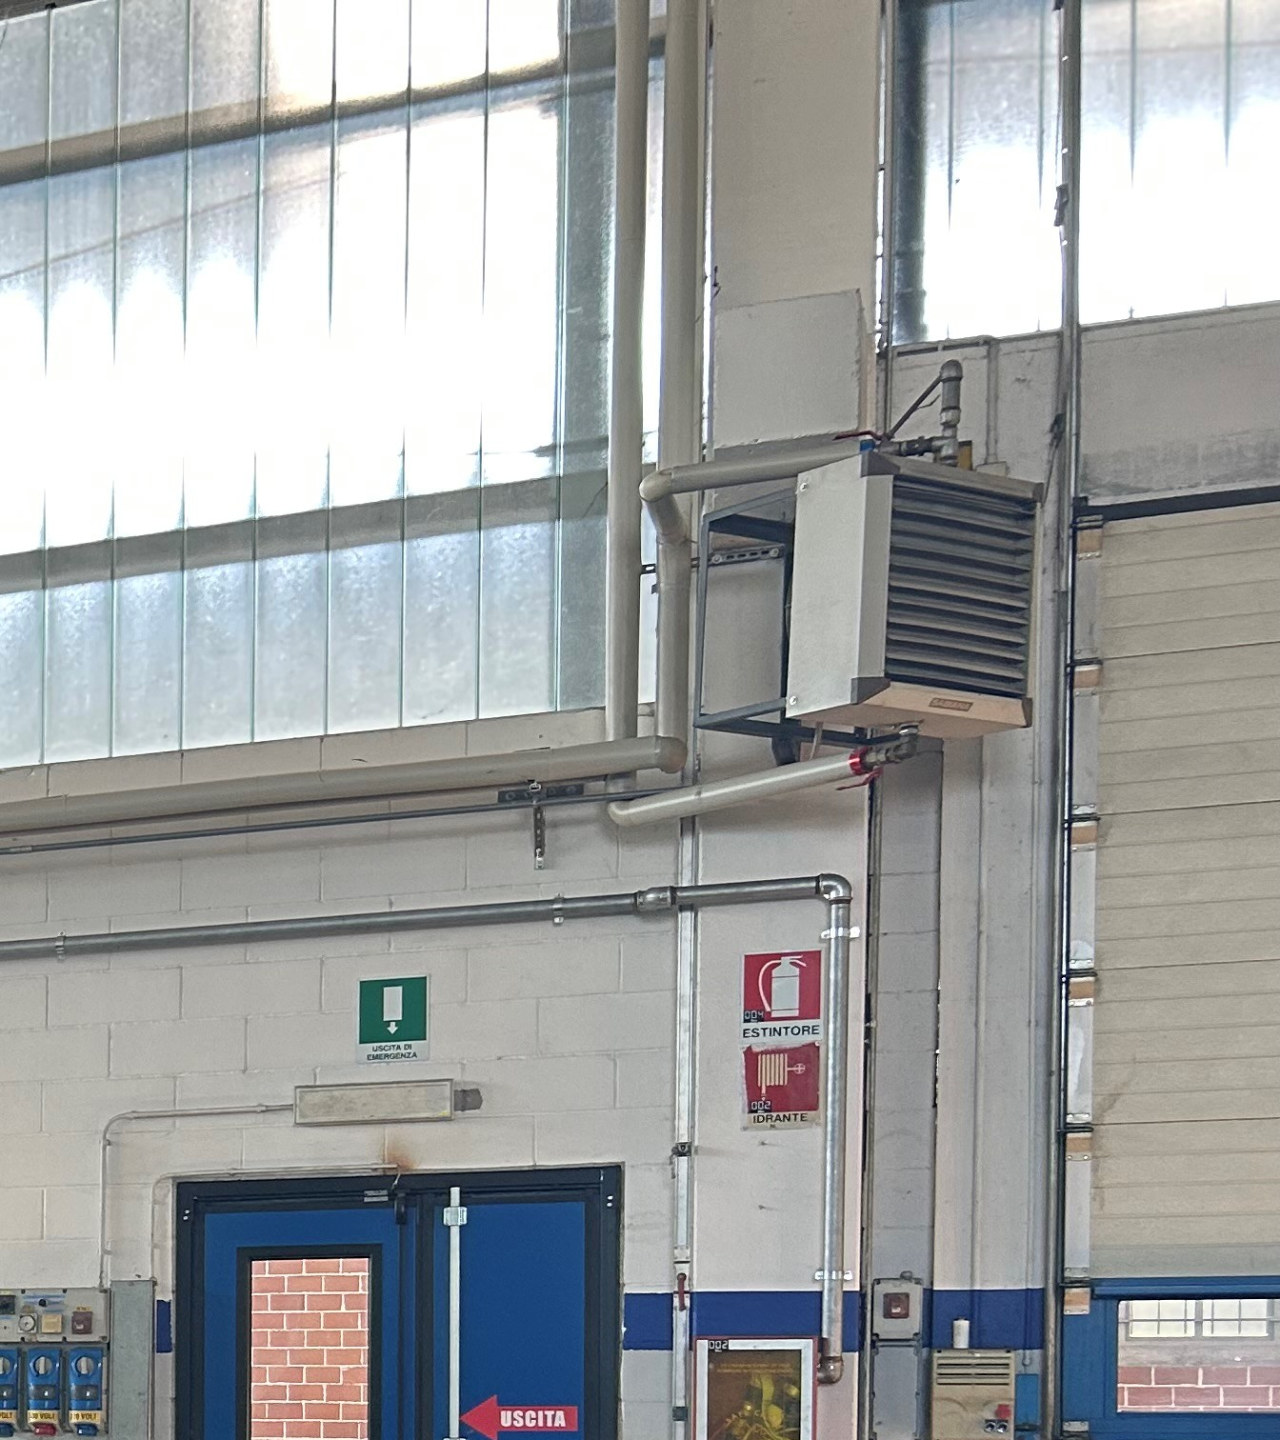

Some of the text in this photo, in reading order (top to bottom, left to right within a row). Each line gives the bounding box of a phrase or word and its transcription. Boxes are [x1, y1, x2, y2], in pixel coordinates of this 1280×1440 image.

[742, 1024, 821, 1039] ESTINTORE
[371, 1043, 412, 1052] USCITA DI
[366, 1051, 418, 1061] EMERGENZA
[752, 1112, 809, 1124] IDRANTE
[500, 1410, 567, 1428] USCITA
